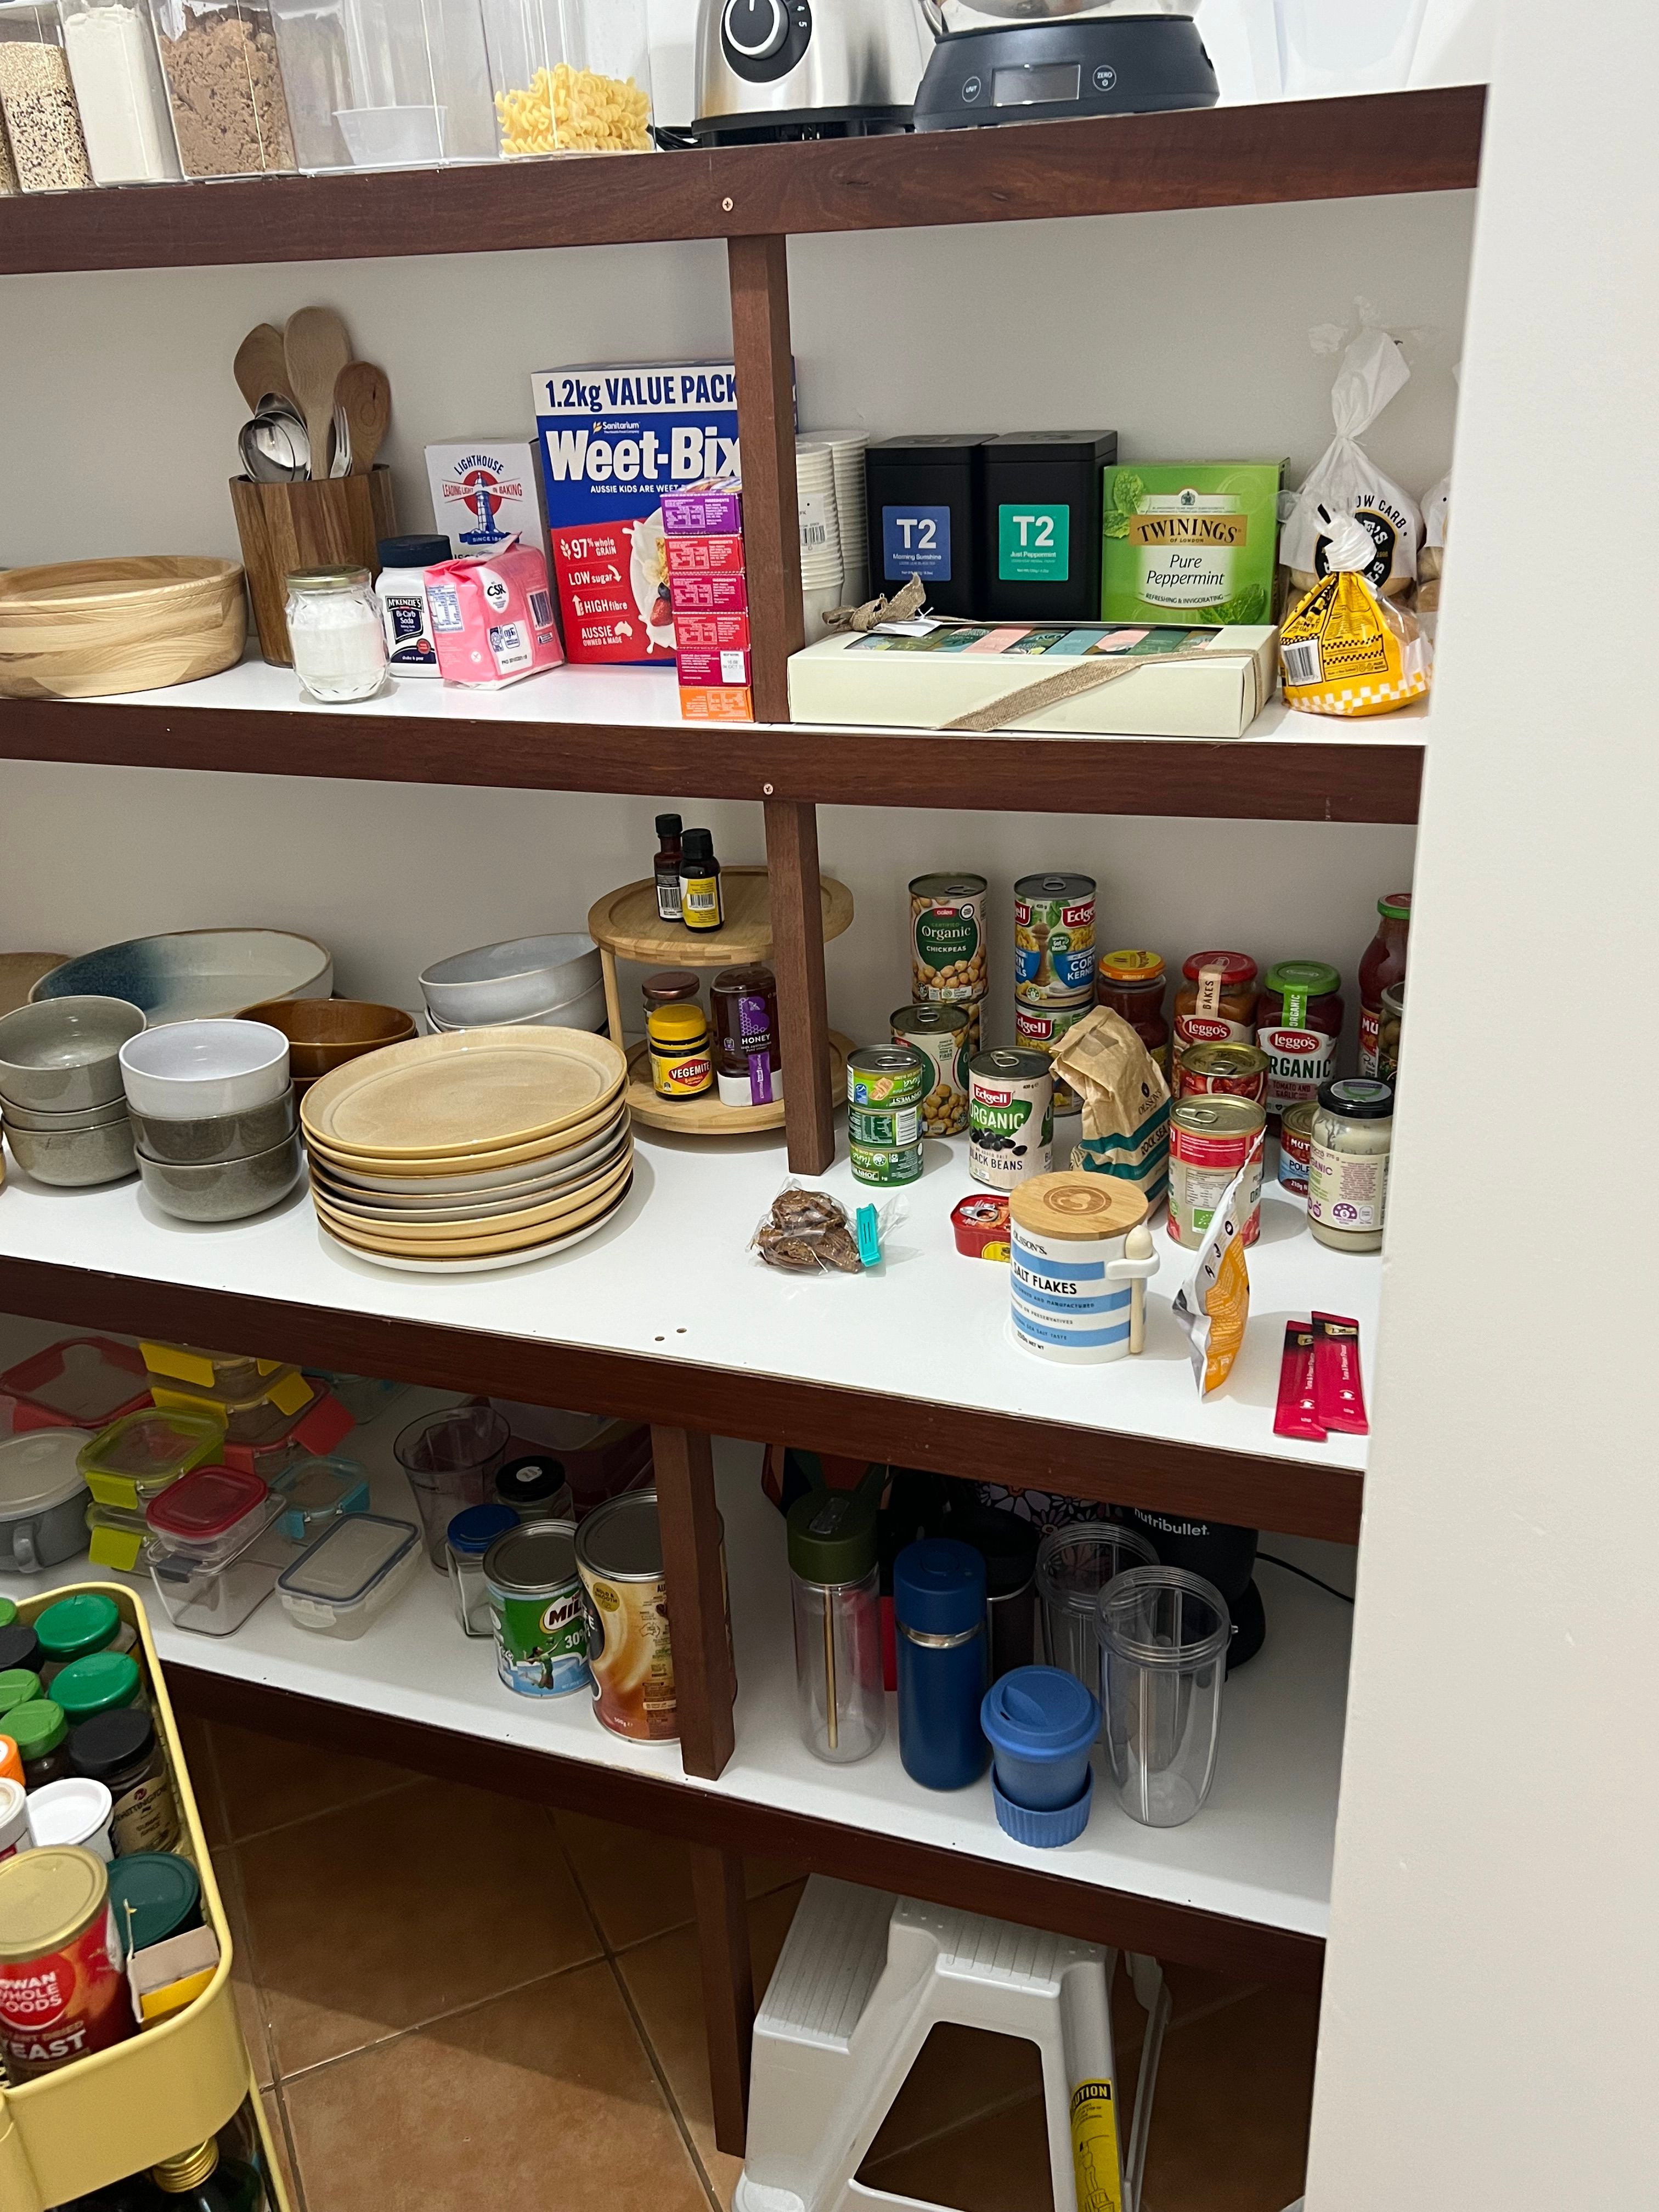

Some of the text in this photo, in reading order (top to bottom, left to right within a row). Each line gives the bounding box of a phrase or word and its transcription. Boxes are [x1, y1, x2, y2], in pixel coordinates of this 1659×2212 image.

[546, 379, 601, 412] 1.2kg
[605, 376, 676, 405] VALUE
[603, 421, 639, 430] Sanitarium
[454, 455, 504, 475] LIGHTHOUSE
[442, 484, 462, 497] LEADING
[499, 483, 522, 496] BAKING
[590, 485, 617, 493] AUSSIE
[639, 484, 654, 493] ARE
[1379, 500, 1407, 528] CARB
[896, 519, 936, 549] T2
[1013, 516, 1054, 546] T2
[1137, 518, 1238, 543] TWININGS
[594, 537, 614, 547] whole
[596, 548, 617, 556] GRAIN
[1170, 554, 1202, 568] Pure
[568, 571, 613, 585] LOW sugar
[1147, 571, 1225, 588] Peppermint
[487, 583, 506, 596] CSR
[1146, 593, 1177, 603] REFRESHING
[1183, 594, 1223, 603] INVIGORATING
[584, 599, 628, 613] HIGH fibre
[582, 625, 613, 639] AUSSIE
[583, 638, 602, 646] OWNED
[607, 636, 623, 644] MADE
[921, 926, 971, 941] Organic
[1203, 980, 1214, 1009] BAKES
[1289, 994, 1300, 1027] ORGANIC
[1017, 1018, 1046, 1034] dgell
[1189, 1021, 1228, 1037] Leggo's
[742, 1034, 770, 1045] HONEY
[1274, 1033, 1316, 1050] Leggo's
[671, 1060, 710, 1080] VEGEMITE
[1269, 1056, 1331, 1079] RGANIC
[1273, 1080, 1296, 1091] TOMATO
[892, 1095, 911, 1104] WEST
[975, 1087, 1007, 1104] Edgell
[1276, 1091, 1298, 1099] GARLIC
[970, 1101, 1024, 1130] ORGANIC
[1156, 1127, 1167, 1142] SEA
[1291, 1138, 1310, 1151] MUT
[991, 1158, 1023, 1170] BEANS
[856, 1169, 876, 1180] JOHN
[1013, 1231, 1047, 1255] OLSSON'S
[1014, 1261, 1076, 1295] SALT FLAKES
[1047, 1300, 1094, 1308] MANUFACTURED
[1031, 1311, 1073, 1325] PRESERVATIVES
[1135, 1508, 1207, 1536] nutribullet
[595, 1592, 618, 1604] SMOOTH
[549, 1602, 582, 1626] MIL
[1074, 2085, 1107, 2106] UTION
